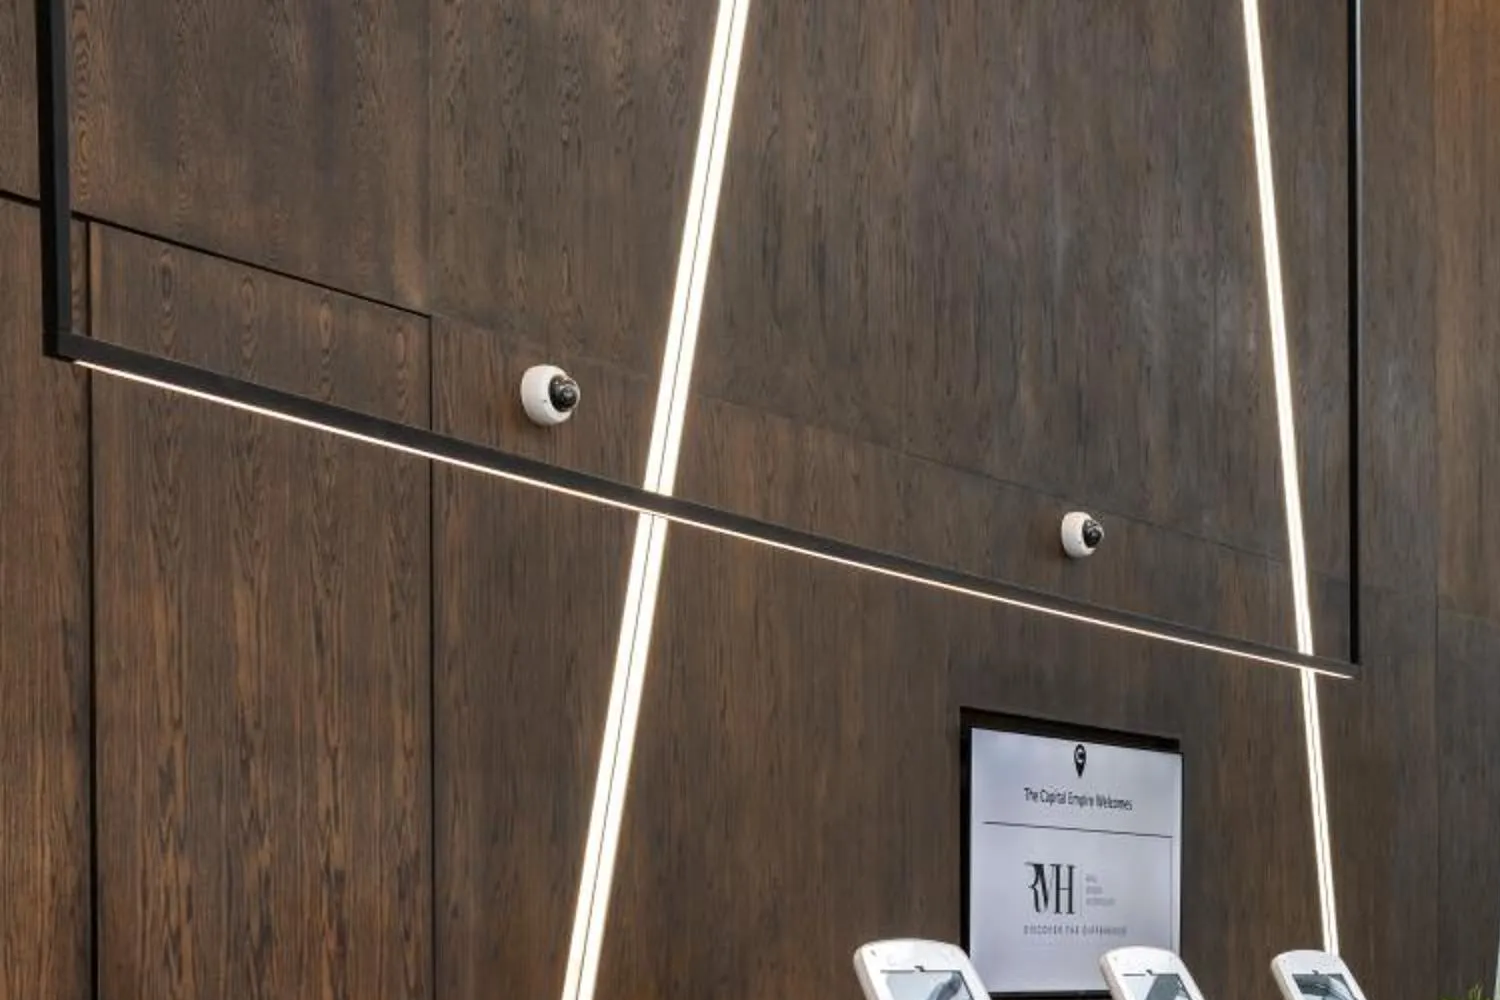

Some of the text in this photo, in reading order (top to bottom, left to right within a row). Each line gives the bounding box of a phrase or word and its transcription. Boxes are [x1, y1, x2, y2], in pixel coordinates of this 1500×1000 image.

[1023, 787, 1133, 811] The Capital Empire Welcomes
